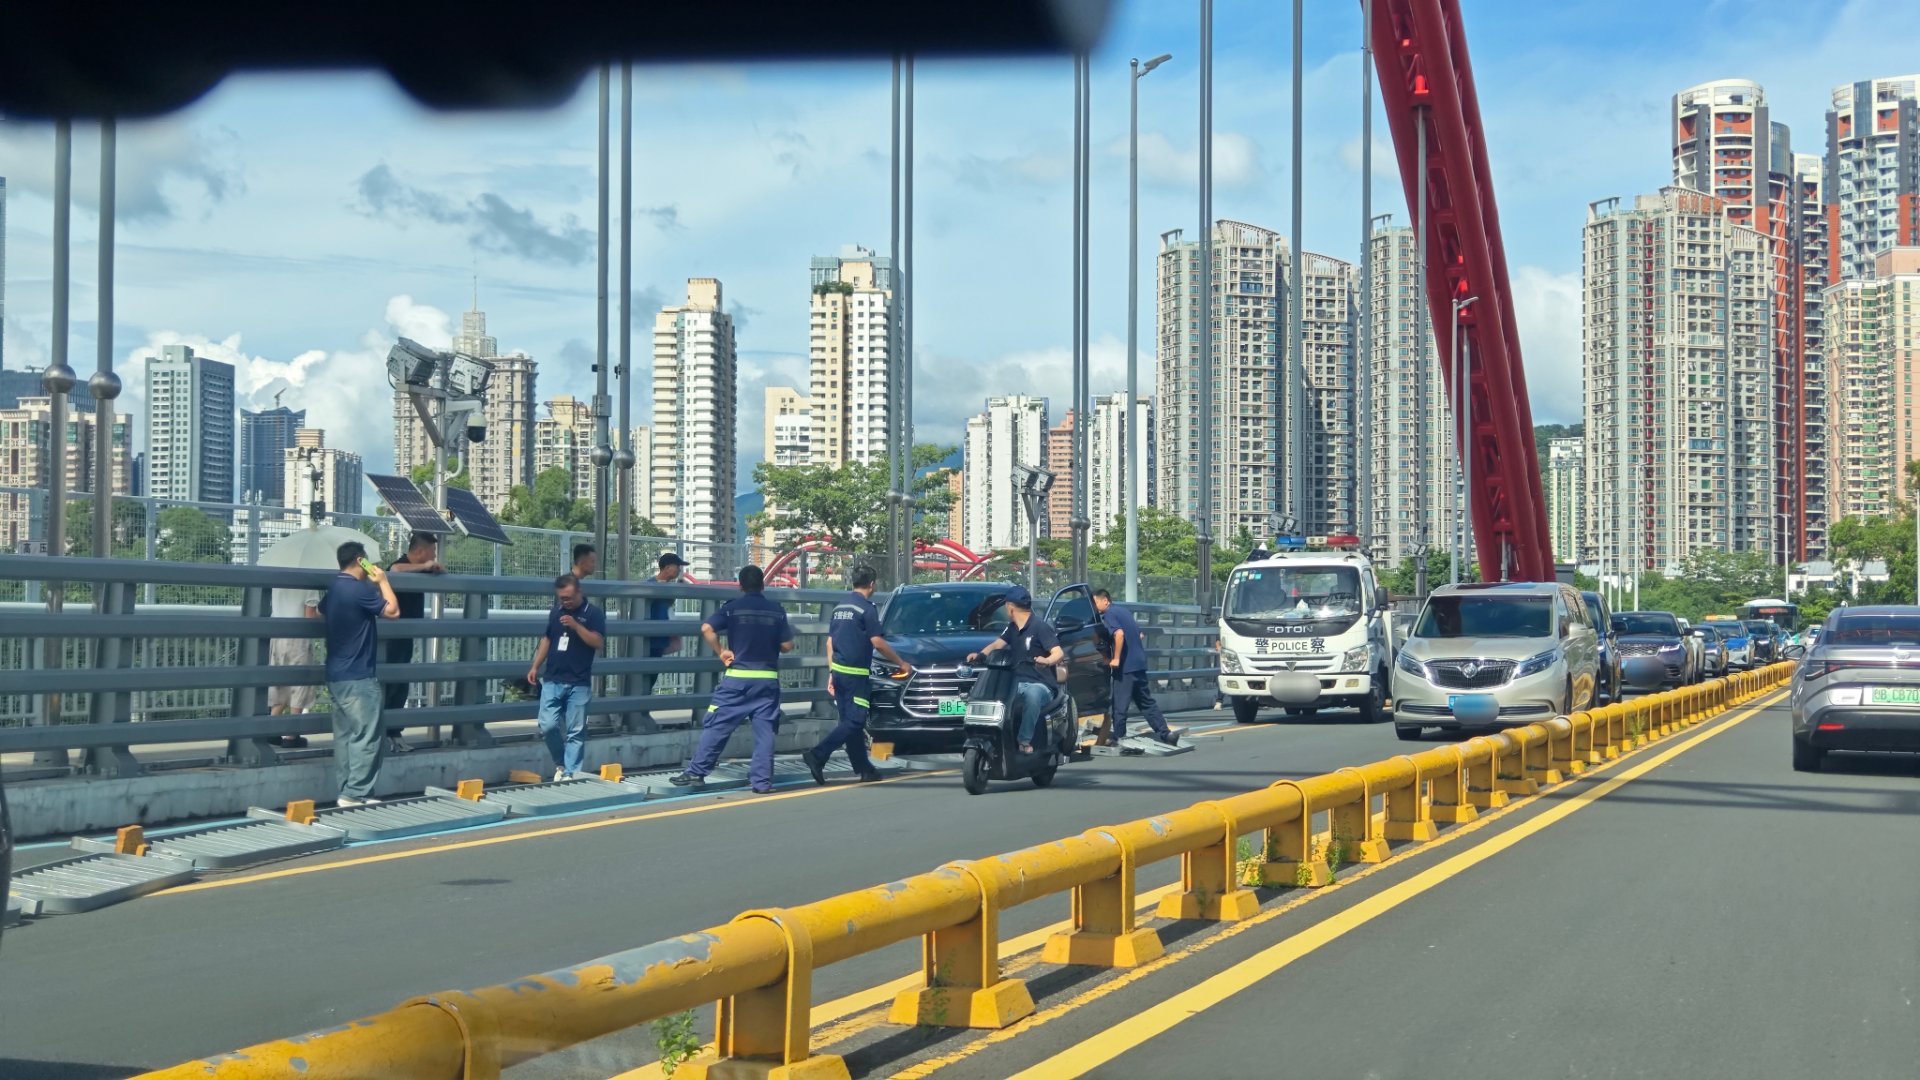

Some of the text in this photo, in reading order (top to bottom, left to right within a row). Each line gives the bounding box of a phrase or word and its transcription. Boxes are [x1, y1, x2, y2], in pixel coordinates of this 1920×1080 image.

[1266, 625, 1313, 634] FOTON
[1255, 637, 1325, 654] 警 POLICE 察
